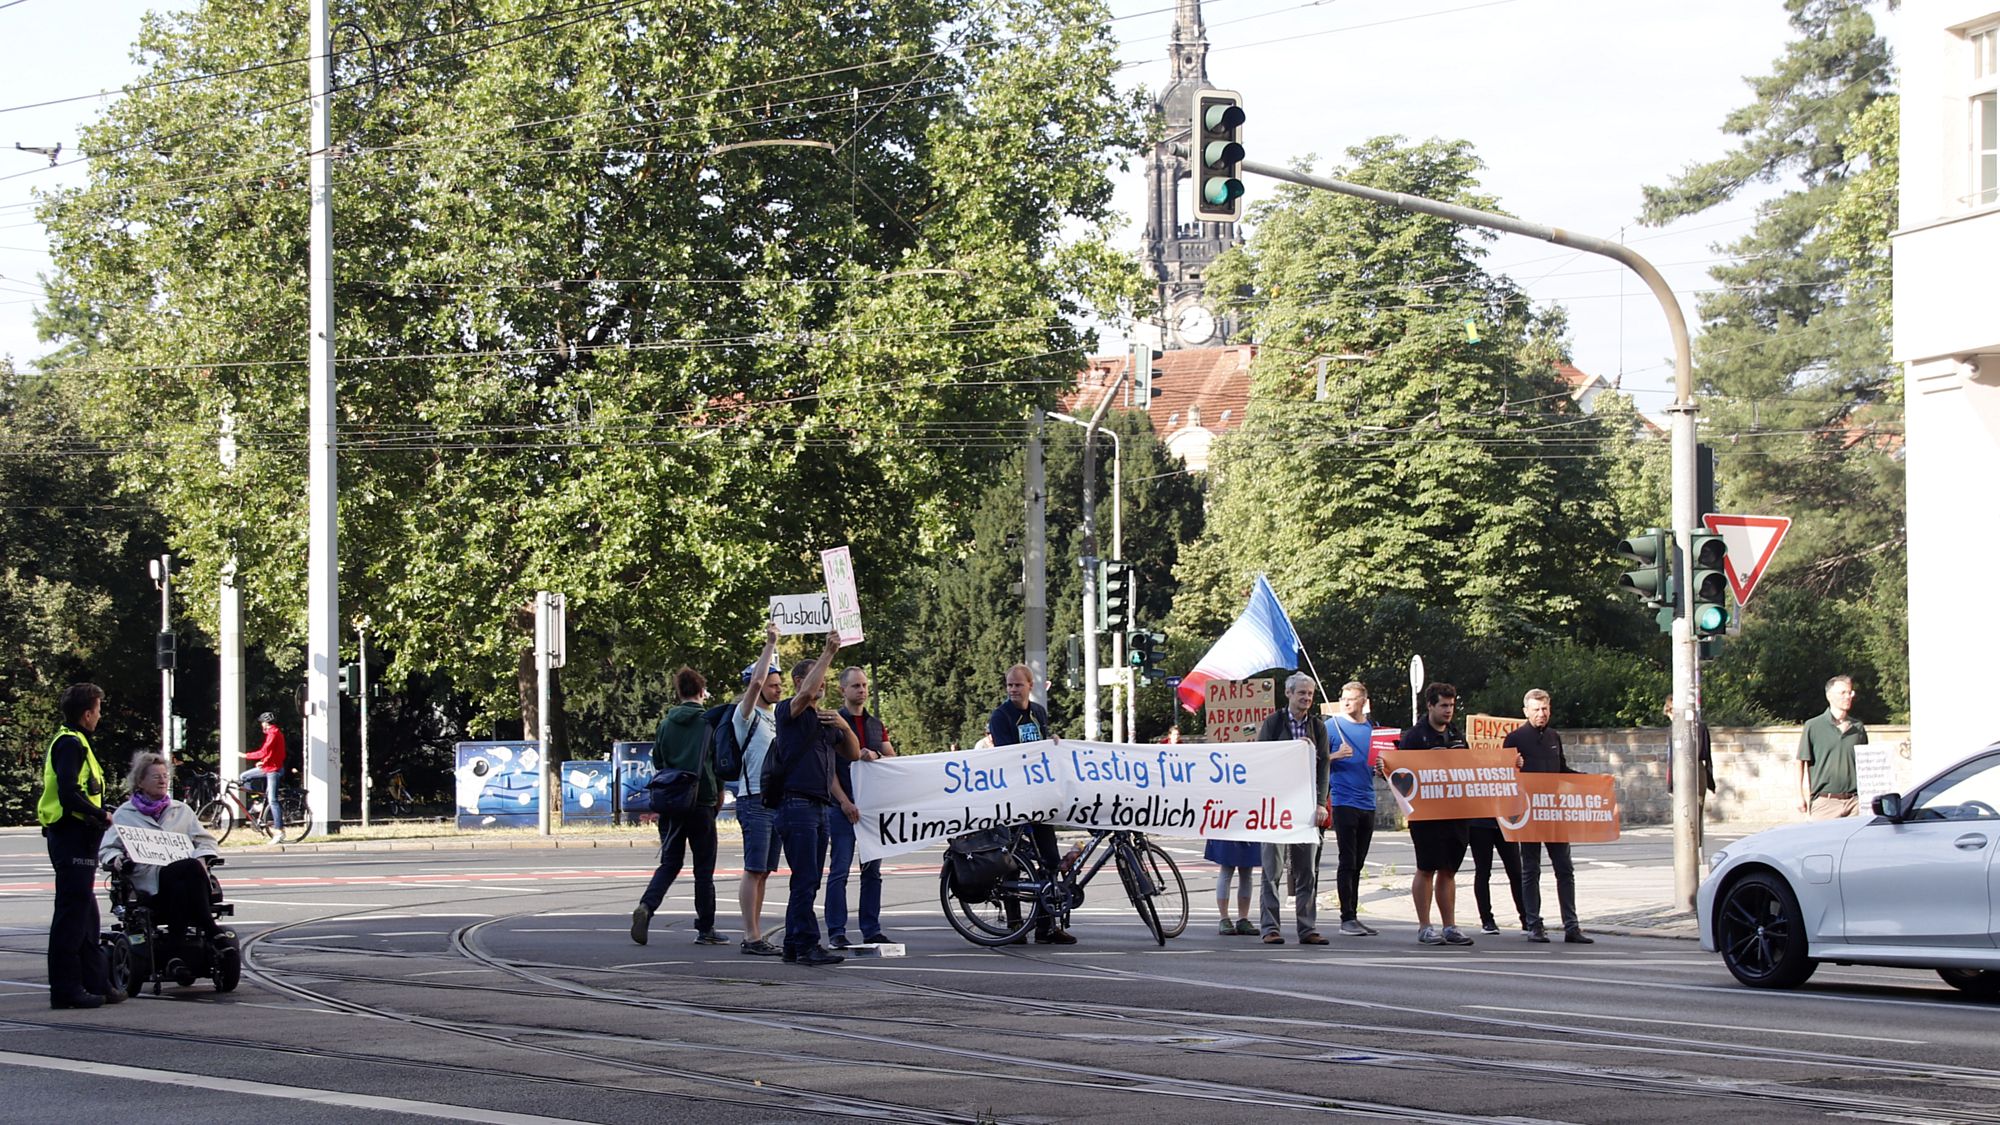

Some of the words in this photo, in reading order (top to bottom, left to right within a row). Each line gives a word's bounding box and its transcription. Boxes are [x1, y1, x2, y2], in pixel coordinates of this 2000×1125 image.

[822, 596, 833, 625] Ö
[1210, 683, 1262, 702] PARIS-
[622, 760, 657, 779] TRA
[944, 760, 1008, 794] Stau
[1022, 752, 1055, 785] ist
[1072, 750, 1150, 788] lästig
[1157, 751, 1196, 788] für
[1209, 752, 1247, 784] Sie
[1418, 769, 1448, 783] WEG
[1448, 768, 1474, 782] VON
[1476, 767, 1516, 781] FOSSIL
[1420, 784, 1444, 800] HIN
[1446, 784, 1463, 798] ZU
[1465, 782, 1518, 798] GERECHT
[1532, 793, 1558, 808] ART.
[1559, 793, 1584, 809] 20A
[1066, 793, 1103, 824] ist
[1110, 794, 1196, 828] tödlich
[1199, 798, 1238, 836] für
[1245, 797, 1294, 830] alle
[1533, 808, 1563, 822] LEBEN
[1564, 807, 1613, 822] SCHÜTZEN
